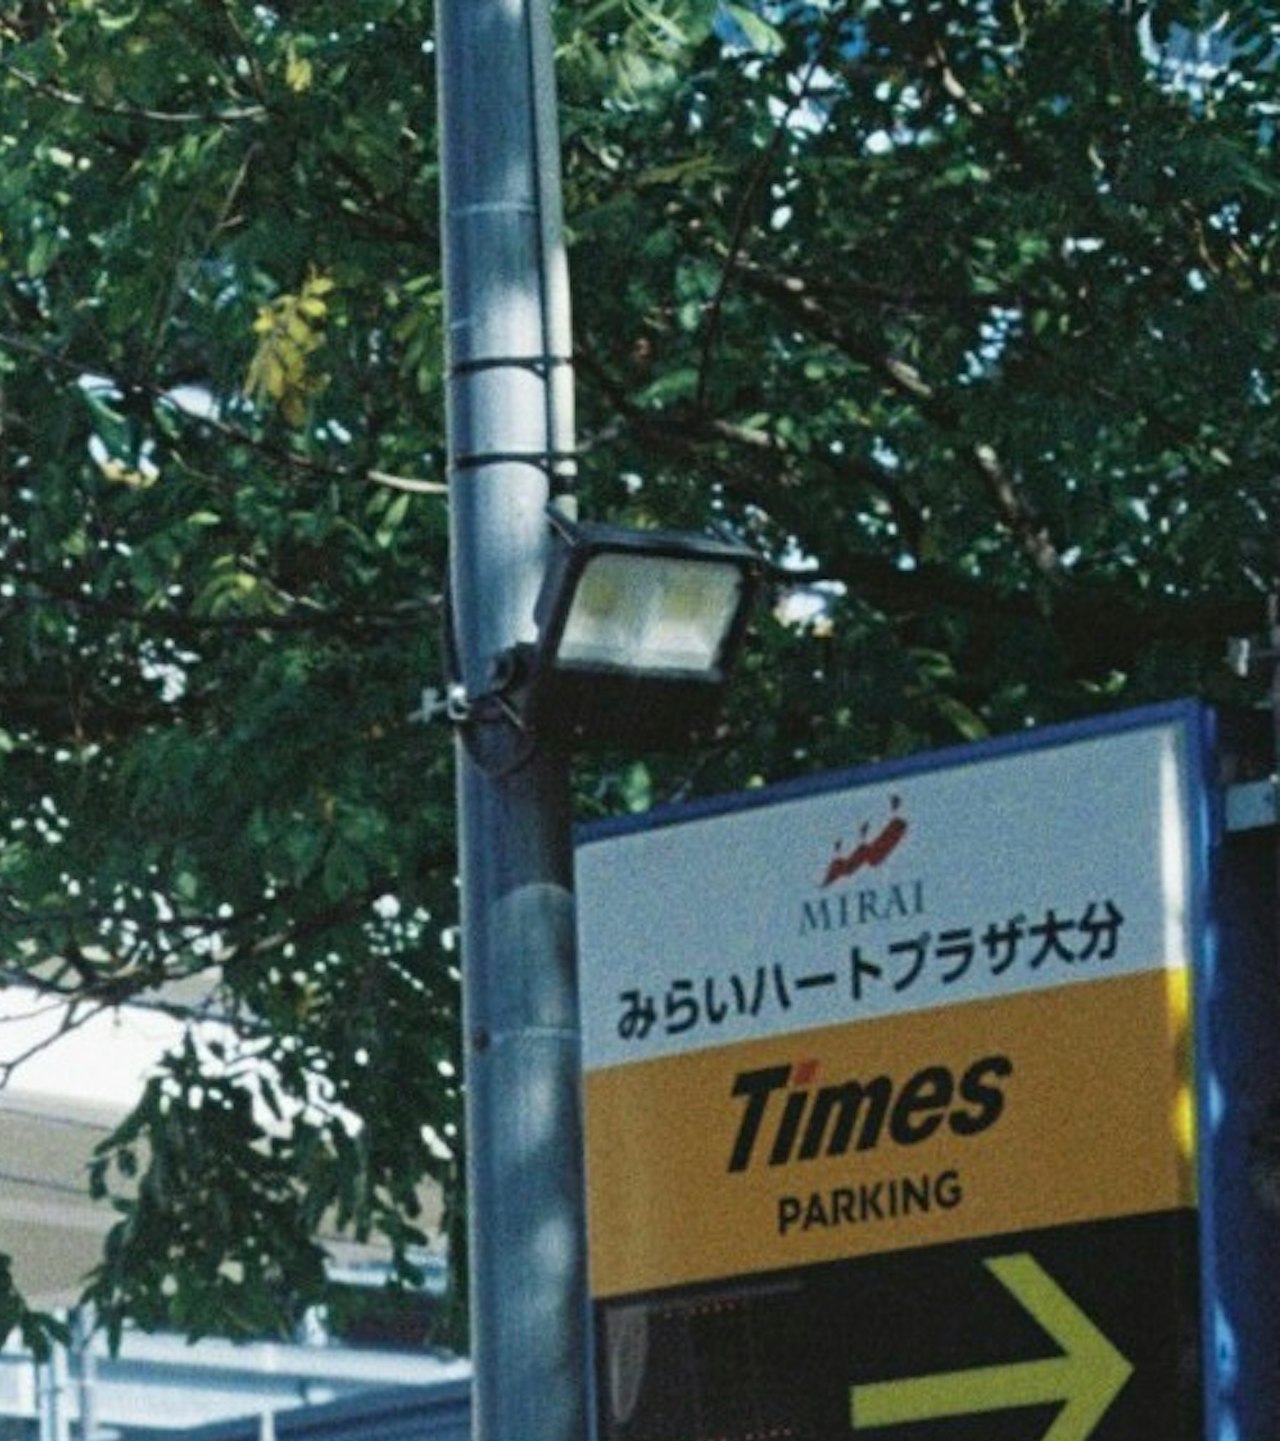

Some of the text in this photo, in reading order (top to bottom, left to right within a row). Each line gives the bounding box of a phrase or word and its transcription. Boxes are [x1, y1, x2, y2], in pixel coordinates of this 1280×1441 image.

[799, 879, 925, 937] MIRAI
[619, 897, 1124, 1042] みらいハートプラザ大分
[728, 1055, 1013, 1173] Times
[777, 1169, 963, 1237] PARKING
